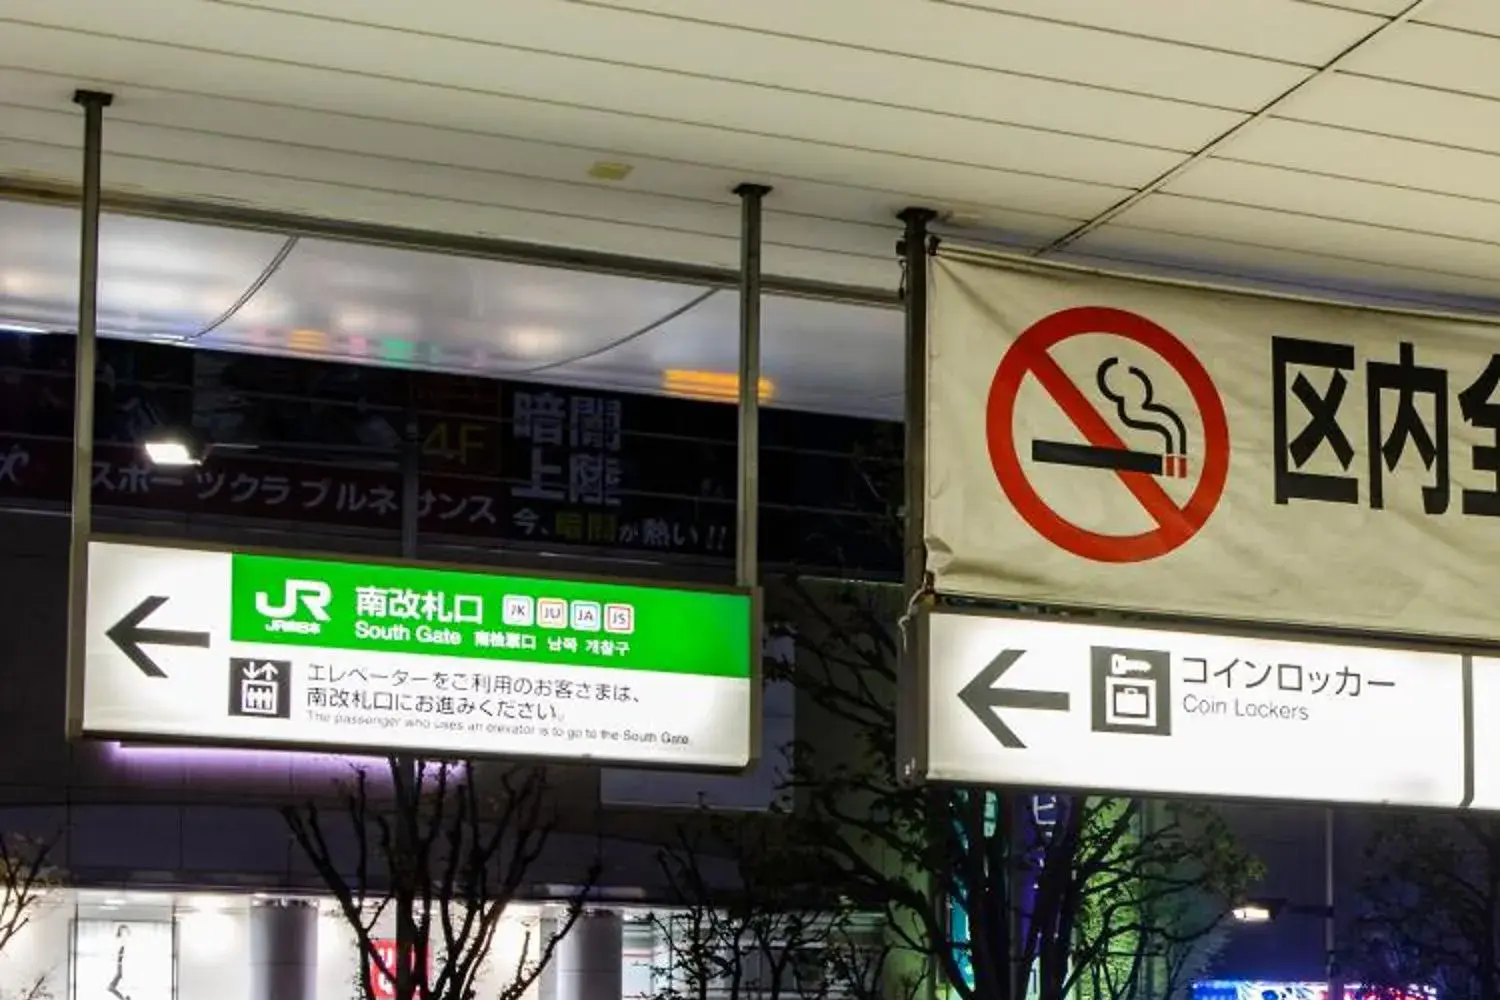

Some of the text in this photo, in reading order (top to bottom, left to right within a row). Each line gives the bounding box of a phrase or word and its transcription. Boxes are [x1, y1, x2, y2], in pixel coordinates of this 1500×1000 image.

[421, 420, 489, 466] 4F
[254, 578, 332, 622] JR
[355, 584, 483, 625] 南改札口
[355, 620, 462, 645] South Gate
[1181, 656, 1397, 698] コインロッカー
[1182, 693, 1310, 722] Coin Lockers
[334, 713, 401, 729] passenger
[567, 729, 583, 742] go
[585, 728, 599, 741] to
[622, 729, 658, 745] South
